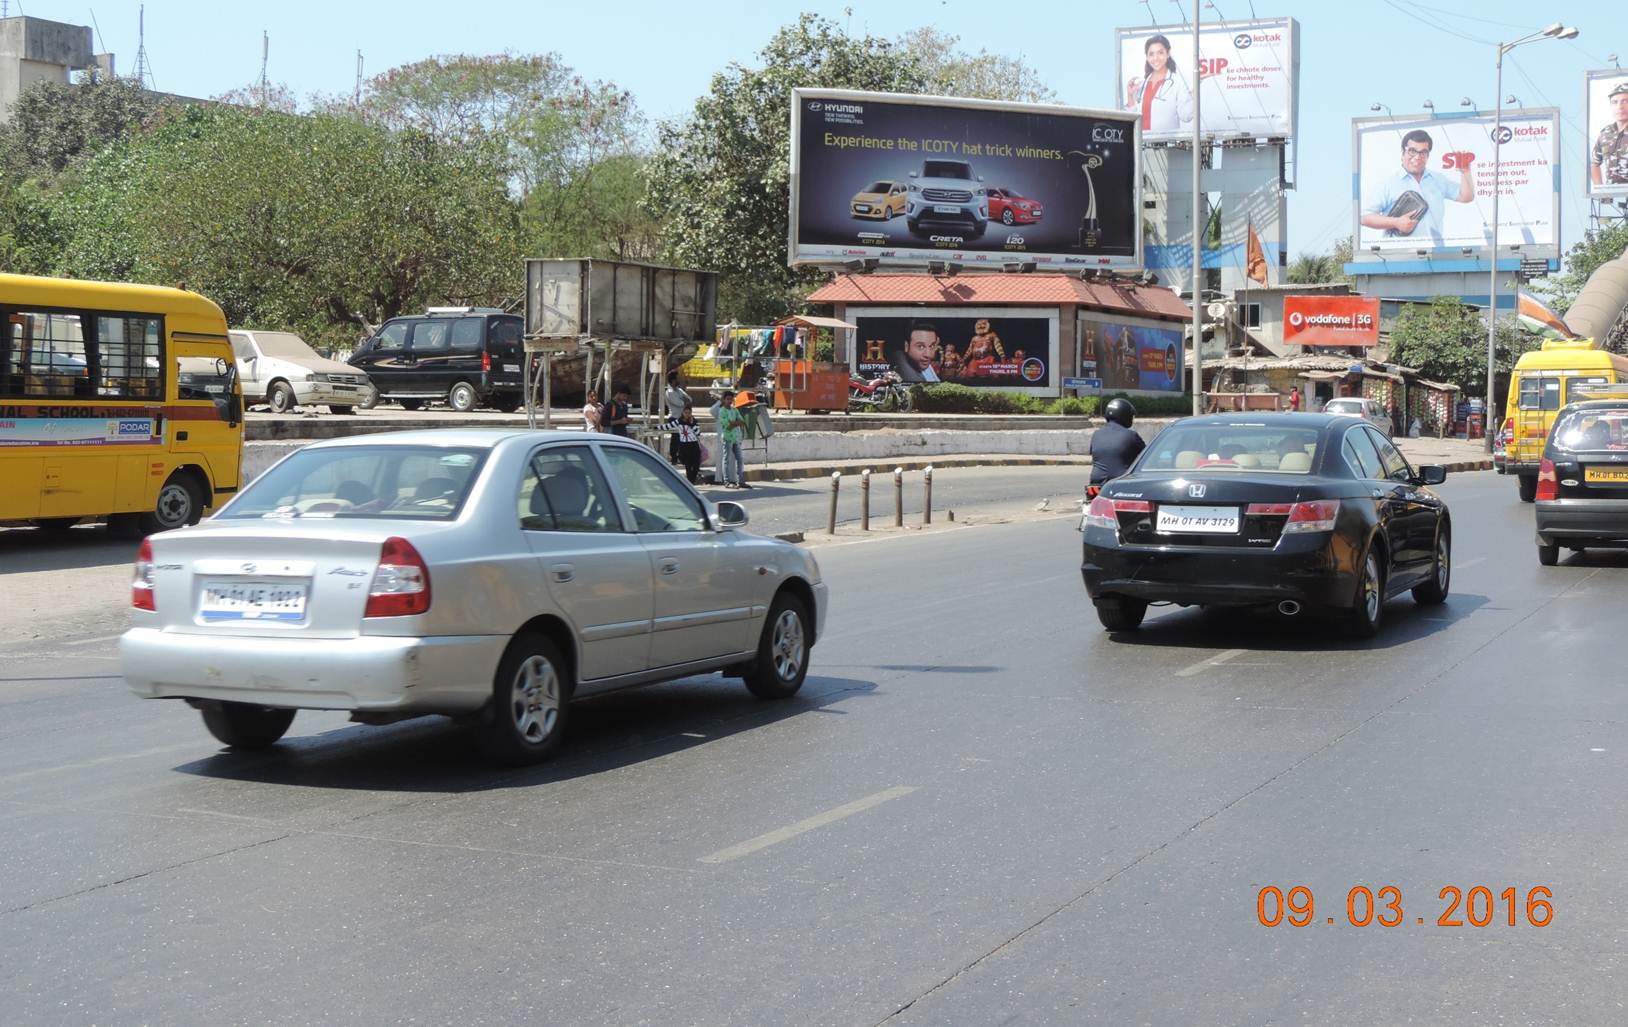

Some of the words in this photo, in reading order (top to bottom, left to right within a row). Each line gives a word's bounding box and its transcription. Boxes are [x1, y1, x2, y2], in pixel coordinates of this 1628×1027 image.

[1253, 33, 1281, 42] kotak
[1199, 57, 1229, 75] SIP
[1238, 74, 1264, 82] healthy
[824, 103, 864, 114] HYUNDAI
[1514, 126, 1548, 136] kotak
[824, 132, 894, 149] Experience
[897, 137, 918, 151] the
[922, 138, 959, 153] ICOTY
[962, 141, 982, 156] hat
[984, 143, 1013, 157] trick
[1015, 147, 1064, 160] winners.
[929, 234, 964, 242] CRETA
[1304, 313, 1350, 324] vodafone
[1356, 314, 1371, 324] 3G
[120, 423, 150, 431] PODAR
[1161, 516, 1179, 525] MH
[1195, 517, 1209, 526] AV
